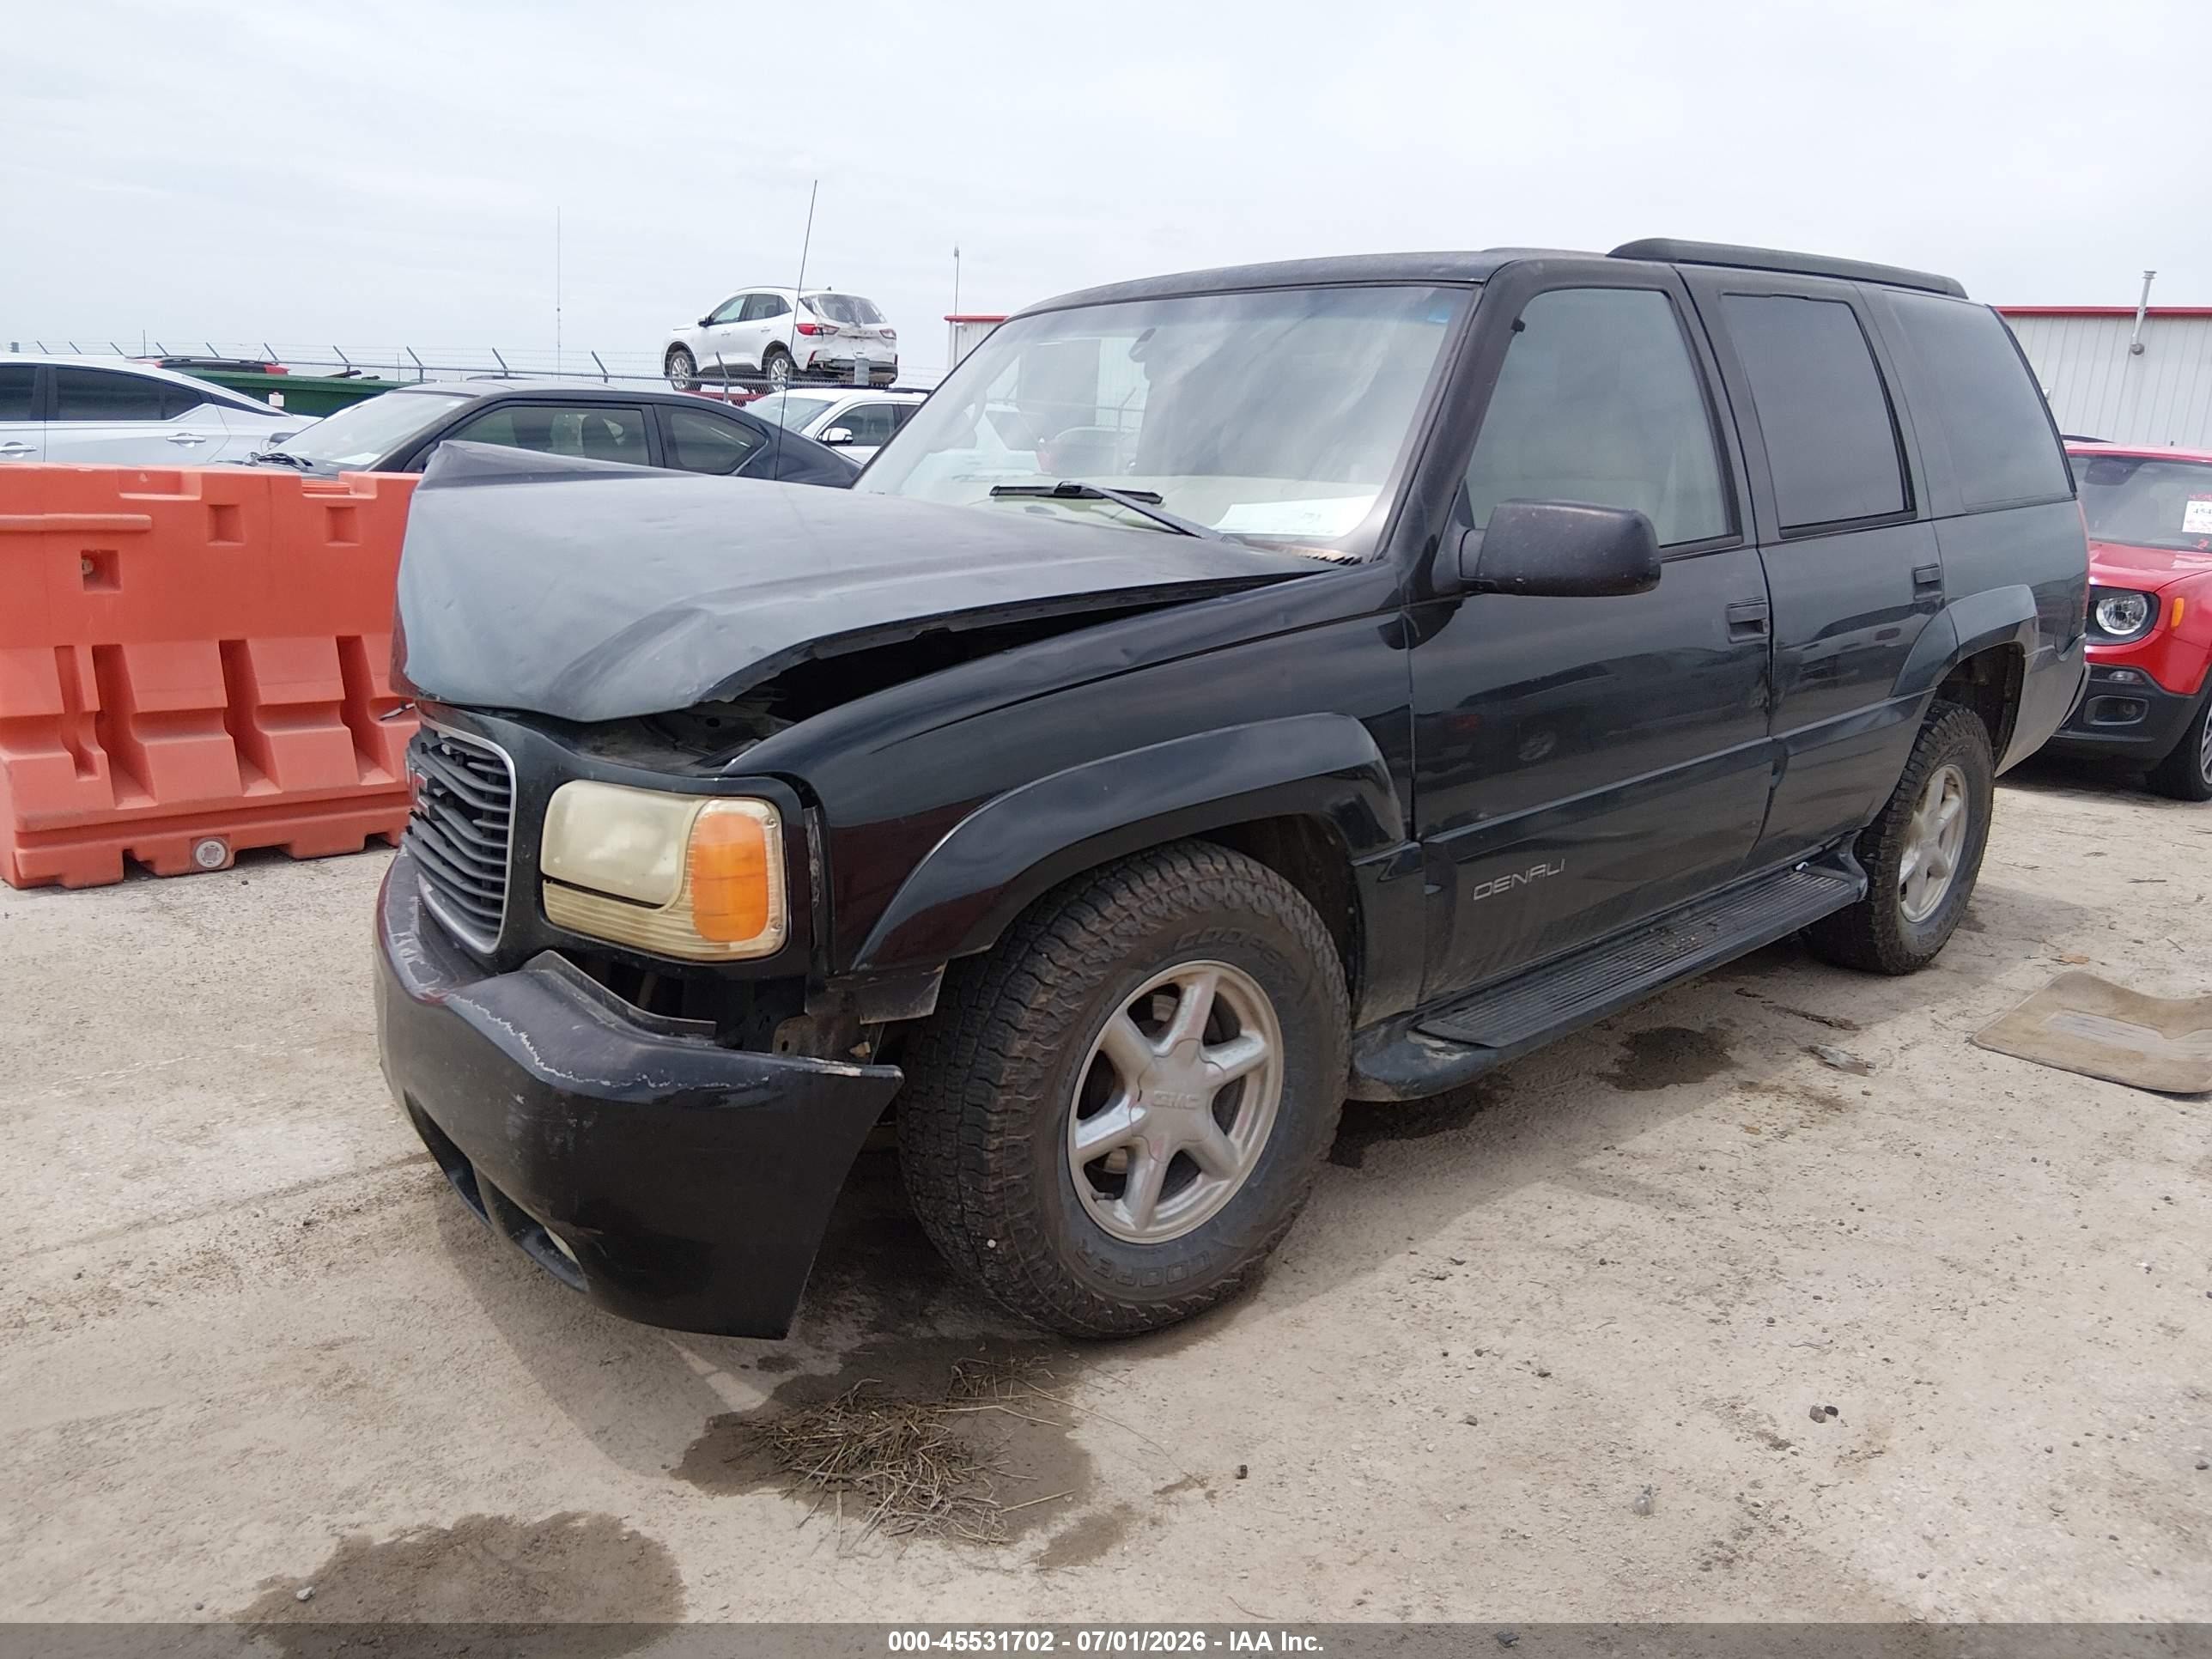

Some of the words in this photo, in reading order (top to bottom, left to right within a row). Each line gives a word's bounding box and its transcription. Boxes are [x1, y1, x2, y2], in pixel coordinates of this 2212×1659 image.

[1473, 858, 1565, 901] DENALI
[1152, 1090, 1203, 1110] GMC
[1075, 1237, 1212, 1288] COOPER
